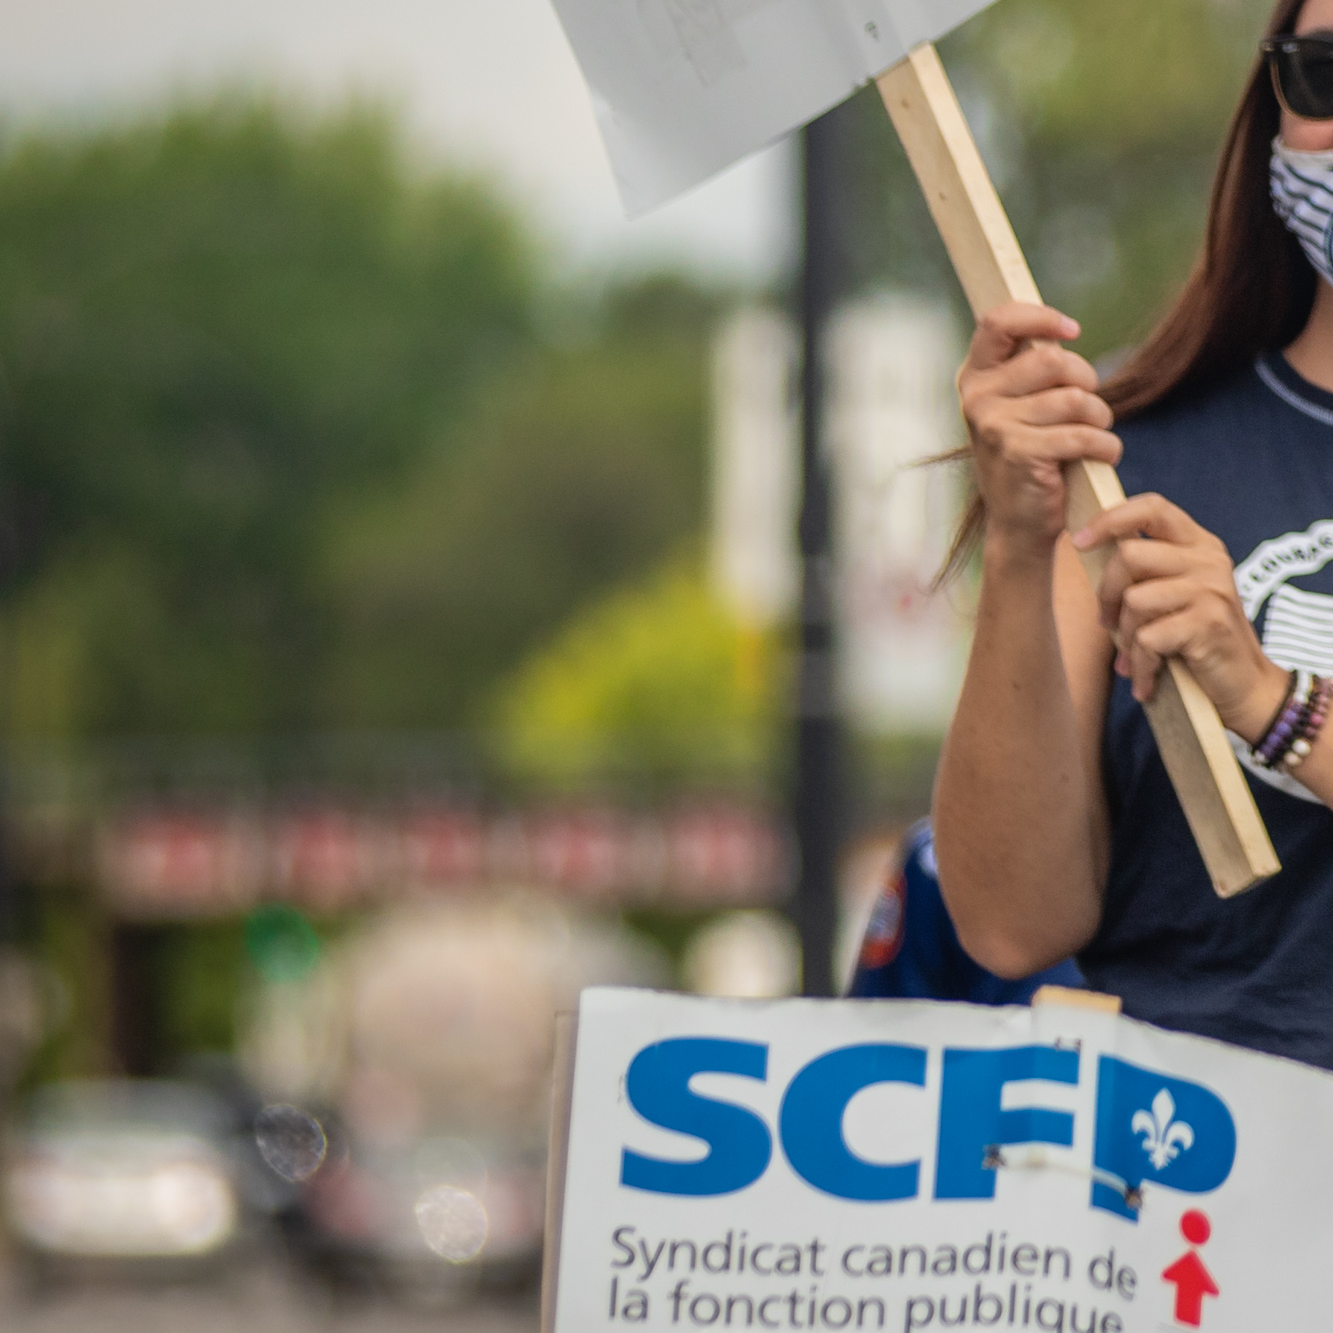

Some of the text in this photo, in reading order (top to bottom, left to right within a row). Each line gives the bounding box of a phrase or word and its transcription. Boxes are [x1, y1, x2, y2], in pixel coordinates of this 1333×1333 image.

[619, 1036, 1236, 1222] SCFP
[609, 1225, 1139, 1301] Syndicat canadien de
[606, 1276, 1125, 1333] la fonction publique
